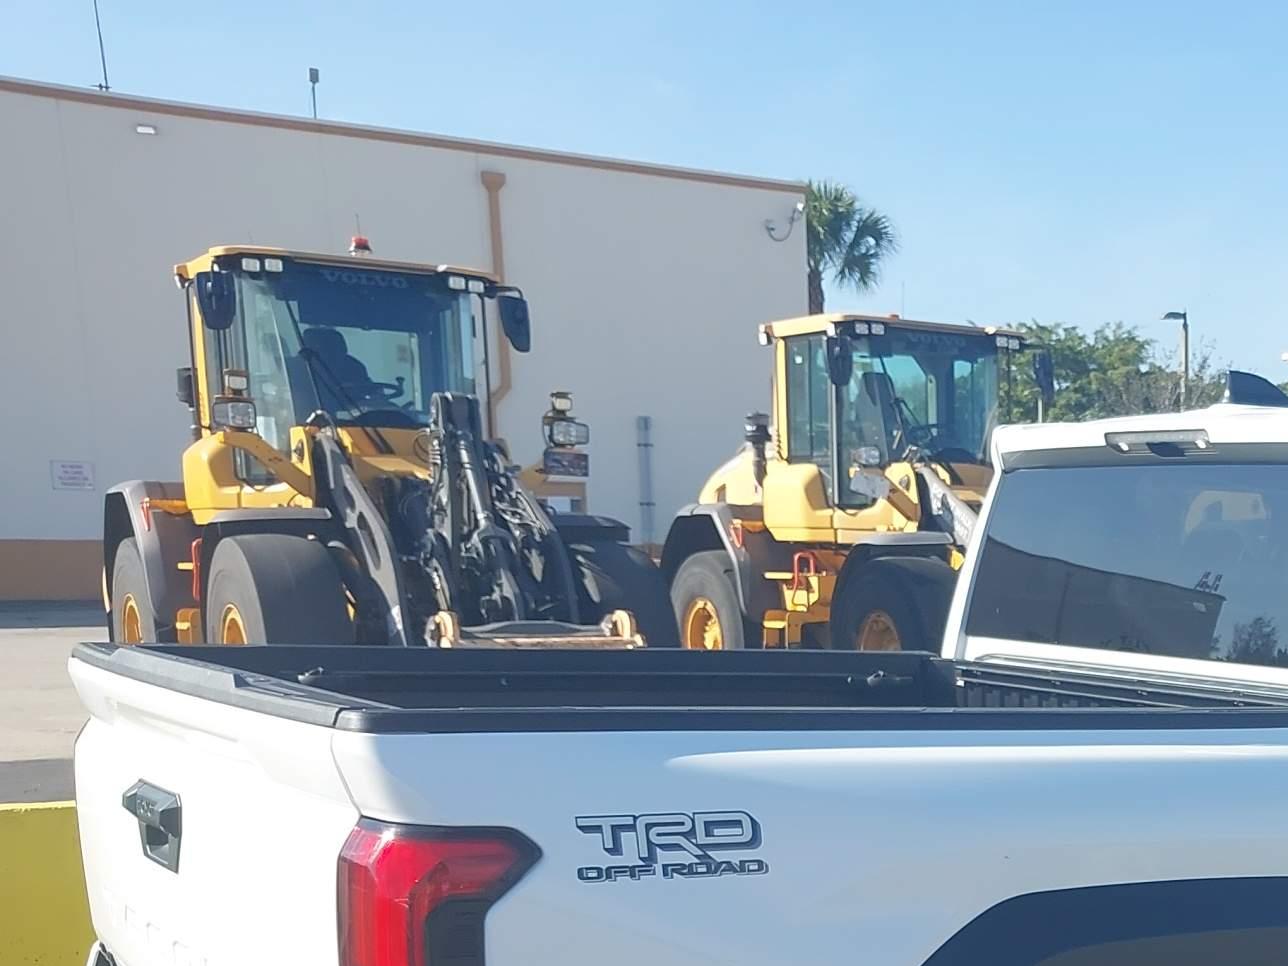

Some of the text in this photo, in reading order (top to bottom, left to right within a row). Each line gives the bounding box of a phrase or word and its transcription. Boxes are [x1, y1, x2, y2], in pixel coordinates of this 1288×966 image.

[320, 269, 409, 289] VOLVO
[575, 811, 763, 864] TRD
[577, 859, 769, 883] OFF ROAD
